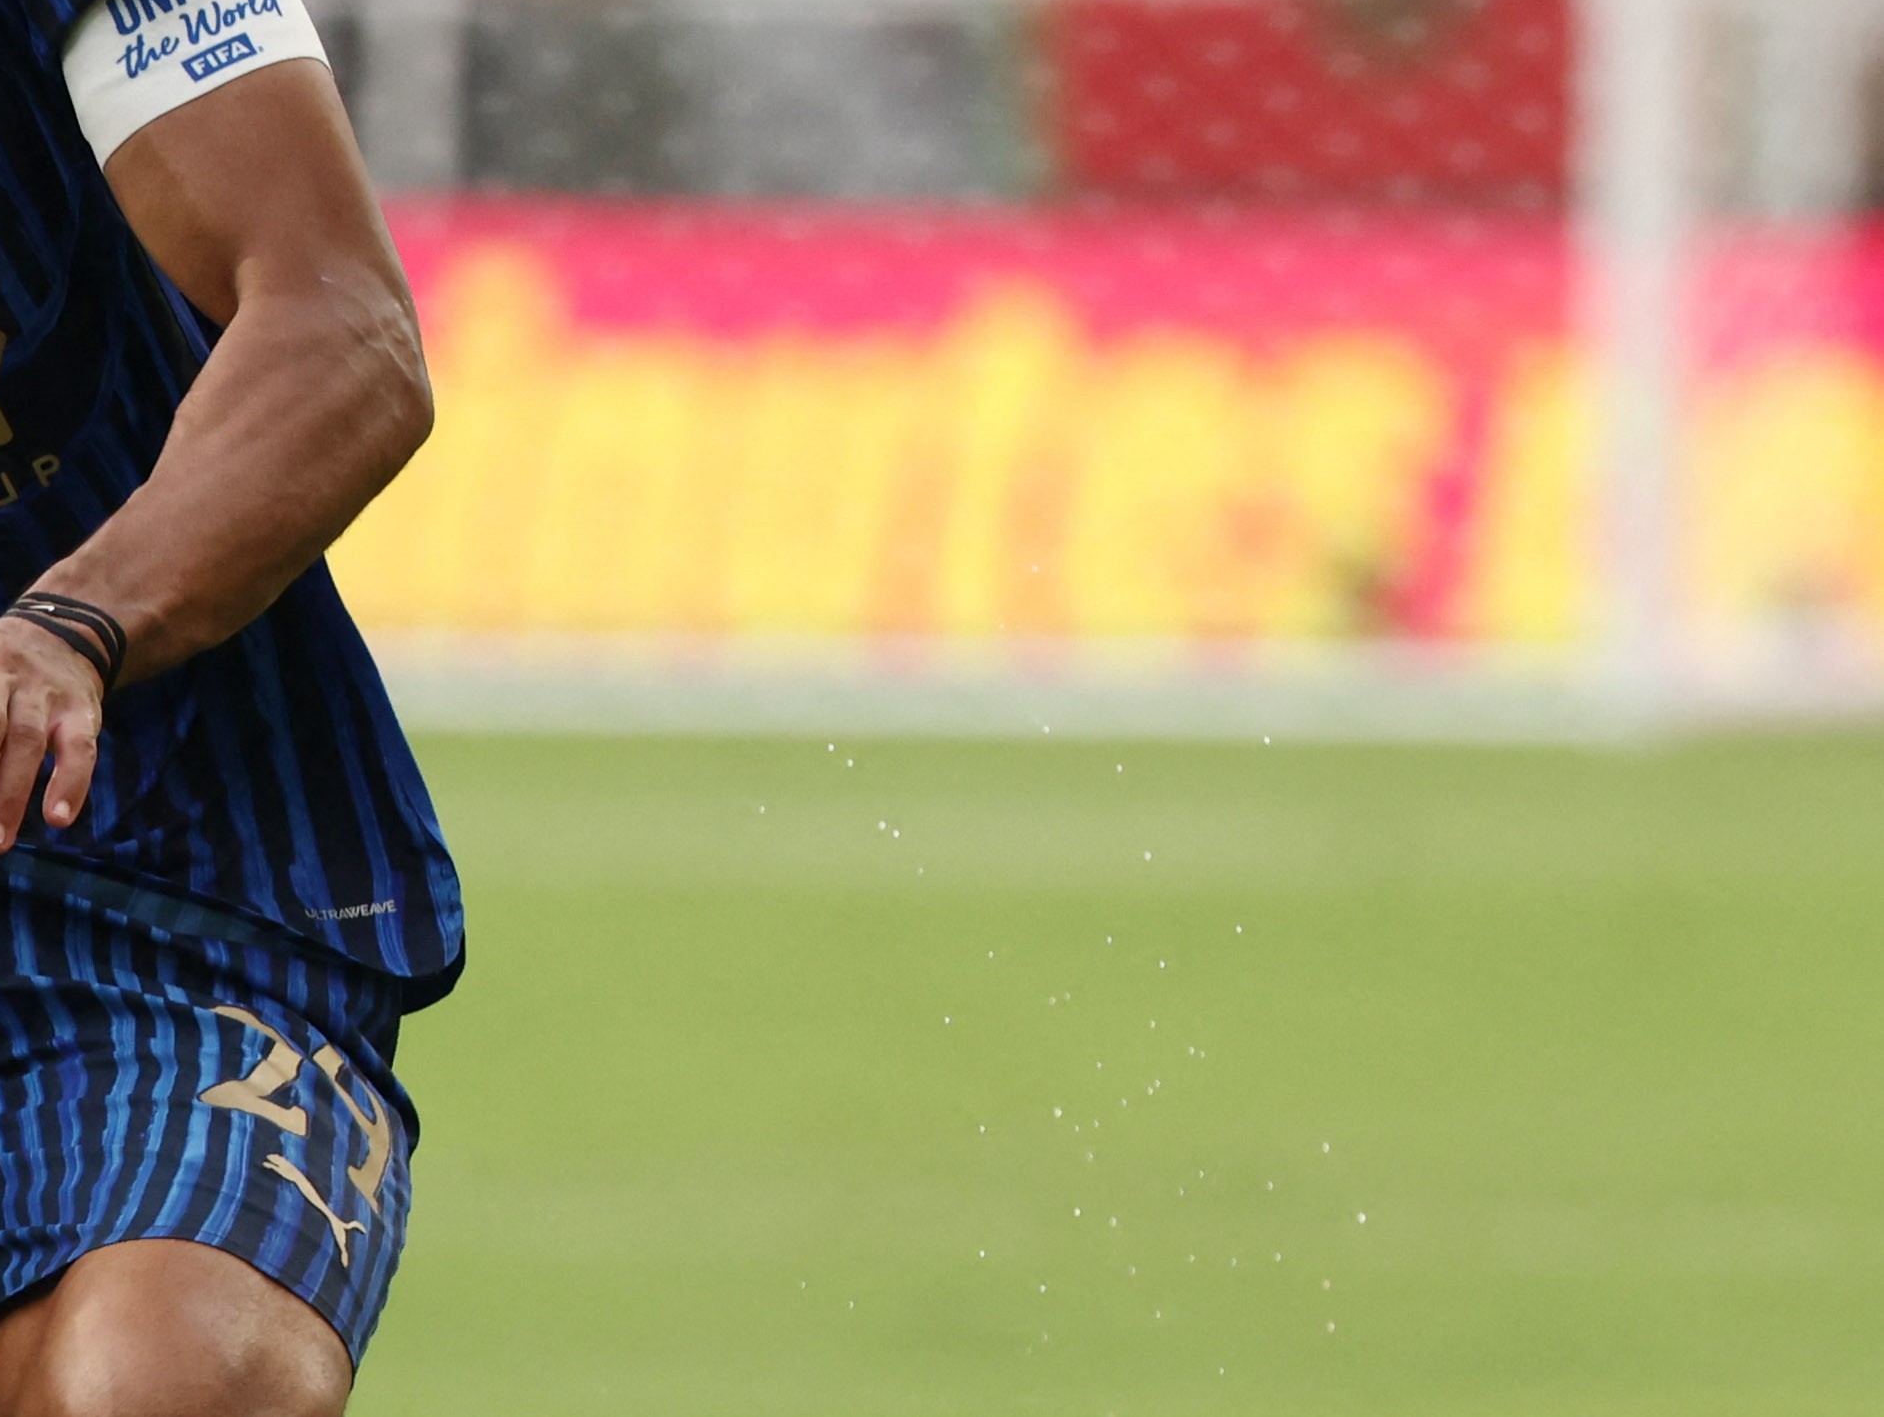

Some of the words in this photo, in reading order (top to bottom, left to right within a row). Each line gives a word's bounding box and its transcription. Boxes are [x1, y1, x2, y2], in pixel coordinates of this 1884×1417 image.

[116, 35, 180, 79] the
[186, 38, 253, 78] FIFA
[305, 899, 397, 921] ULTRAWEAVE
